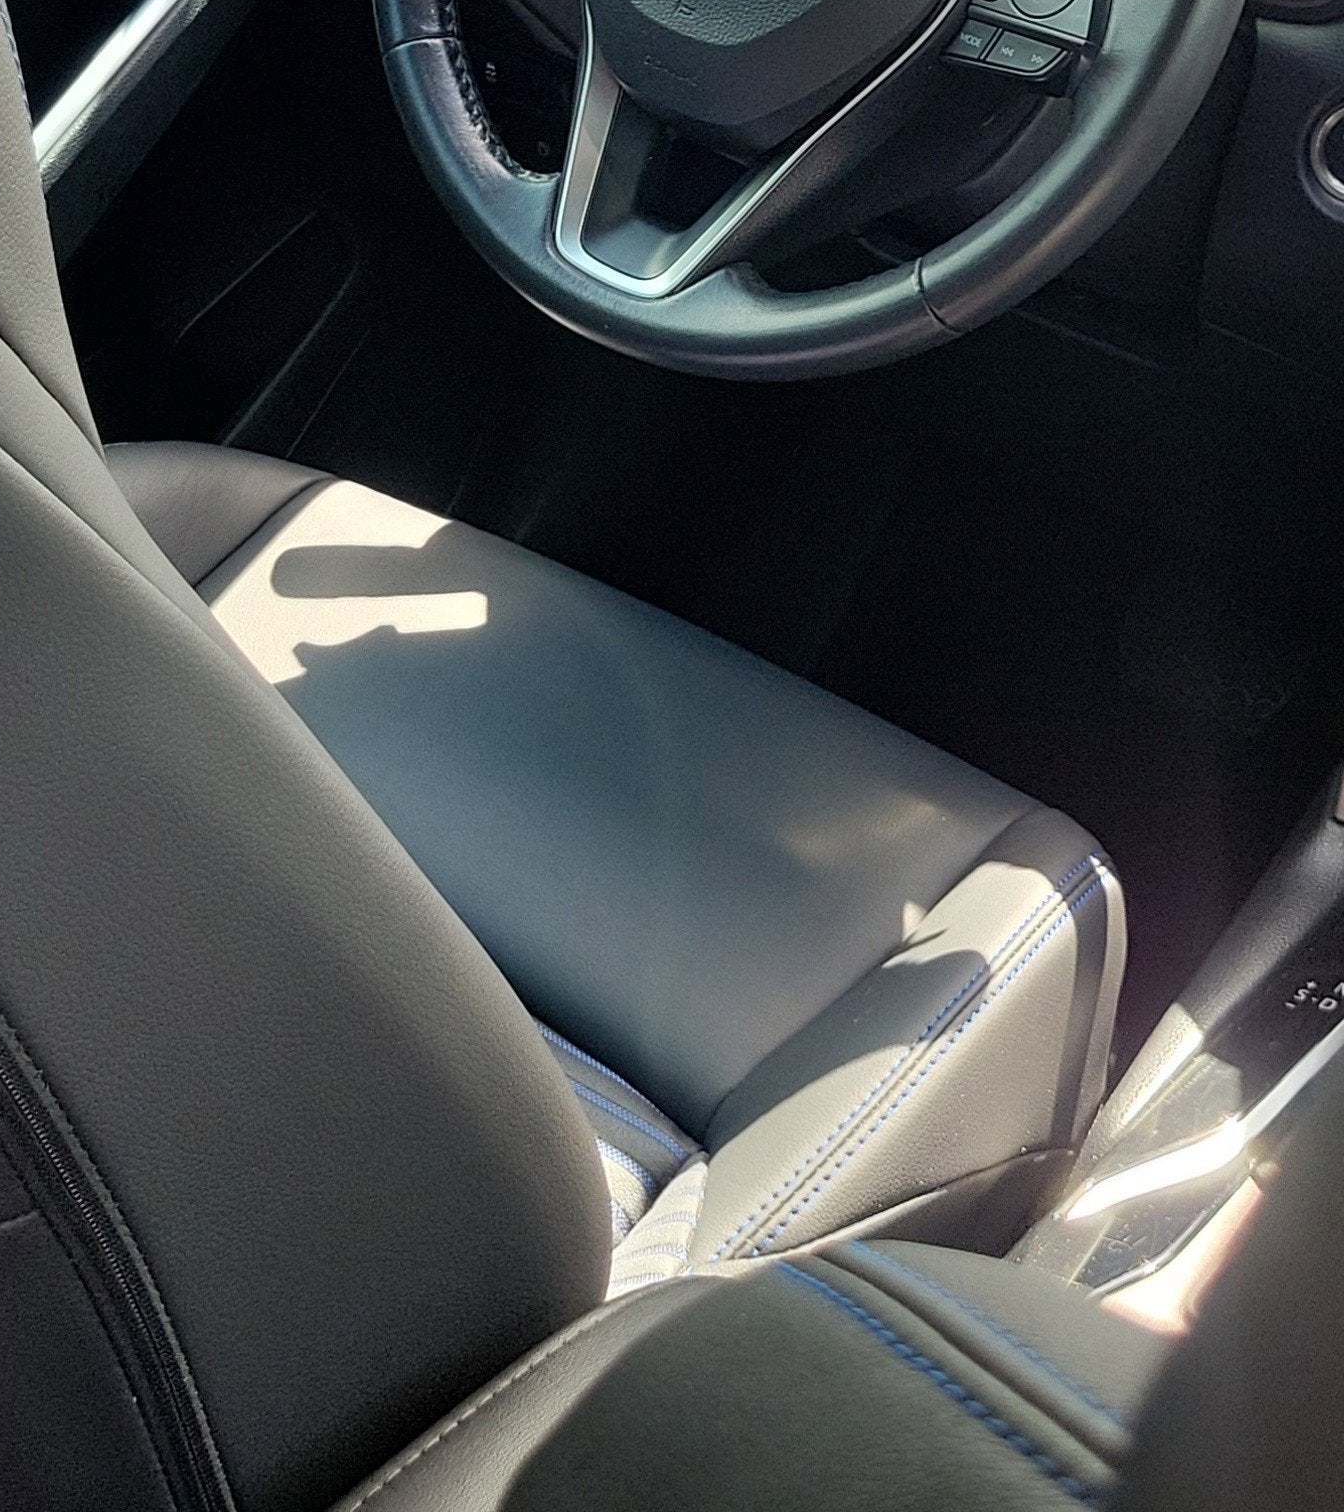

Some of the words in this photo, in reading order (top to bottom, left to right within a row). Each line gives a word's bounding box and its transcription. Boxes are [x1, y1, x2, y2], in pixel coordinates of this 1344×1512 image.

[960, 32, 982, 48] MODE
[1293, 988, 1310, 1001] S
[1318, 996, 1338, 1011] D
